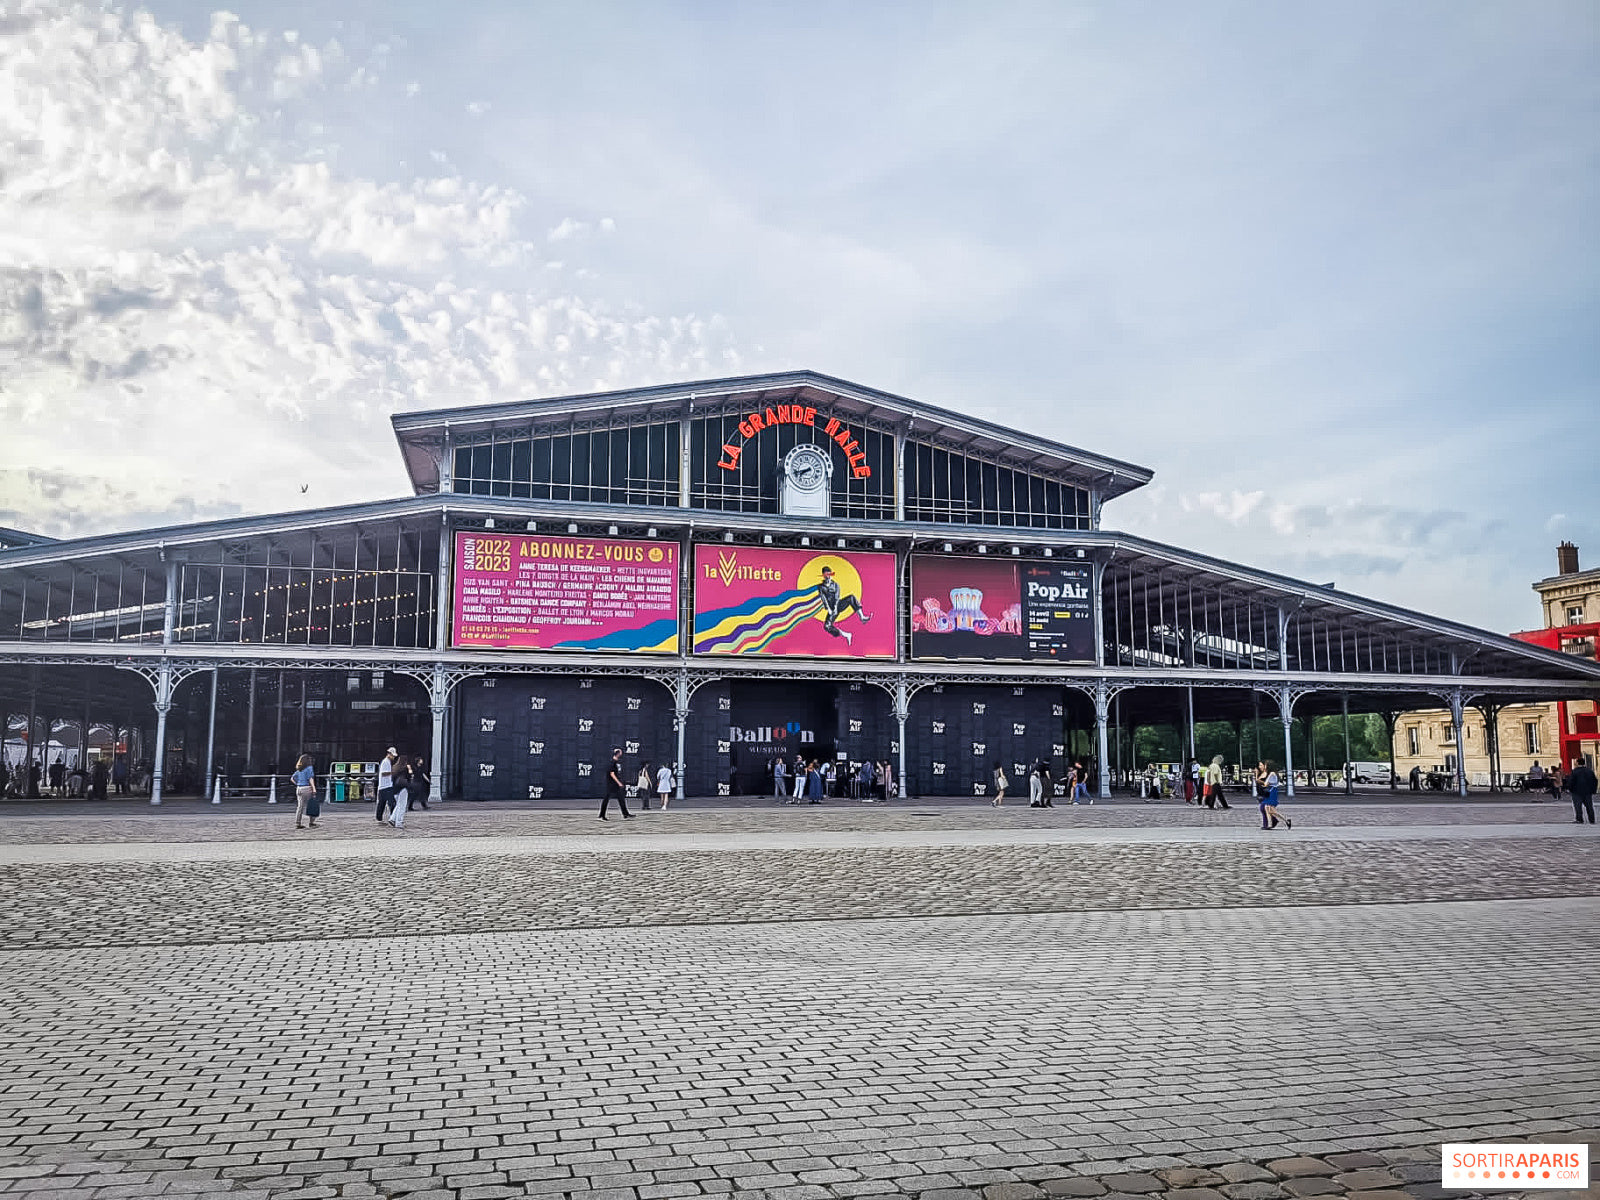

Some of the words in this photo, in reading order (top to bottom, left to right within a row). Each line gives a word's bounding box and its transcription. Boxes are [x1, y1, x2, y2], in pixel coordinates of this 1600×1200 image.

[717, 443, 742, 471] LA
[738, 404, 818, 439] GRANDE
[824, 416, 872, 478] HALLE
[464, 538, 476, 570] SAISON
[476, 540, 512, 556] 2022
[520, 541, 644, 562] ABONNEZ-VOUS
[475, 556, 511, 572] 2023
[538, 563, 559, 572] TERESA
[1028, 582, 1060, 601] Pop
[1061, 583, 1088, 598] Air
